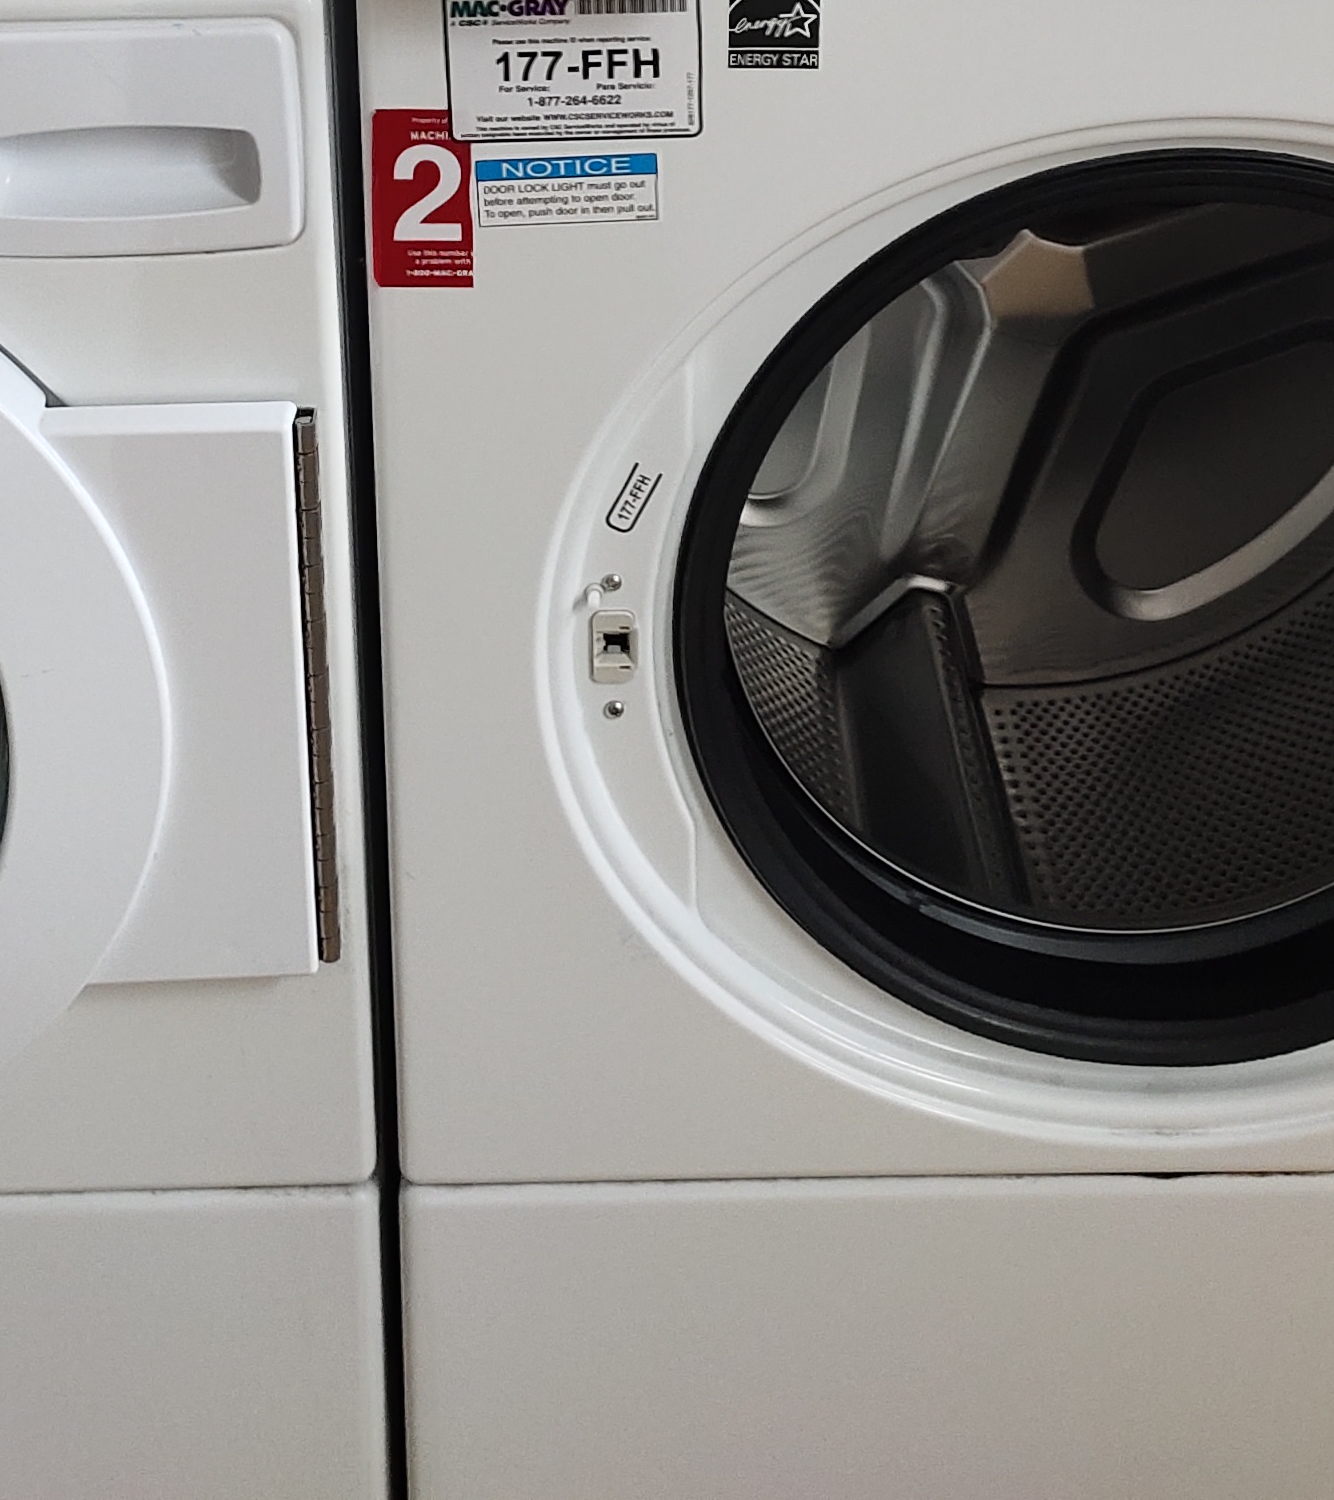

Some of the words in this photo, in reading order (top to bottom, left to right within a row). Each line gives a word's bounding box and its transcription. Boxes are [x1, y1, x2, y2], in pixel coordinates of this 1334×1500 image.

[496, 47, 659, 81] 177-FFH
[729, 53, 779, 66] ENERGY
[781, 53, 818, 66] STAR
[595, 82, 615, 90] Para
[527, 94, 621, 106] 1-877-264-6622
[501, 157, 630, 178] NOTICE
[392, 143, 463, 242] 2
[483, 184, 515, 194] DOOR
[517, 183, 548, 193] LOCK
[551, 181, 584, 191] LIGHT
[586, 181, 611, 189] must
[613, 181, 627, 191] go
[629, 179, 645, 188] out
[617, 474, 652, 521] 177-FFH
